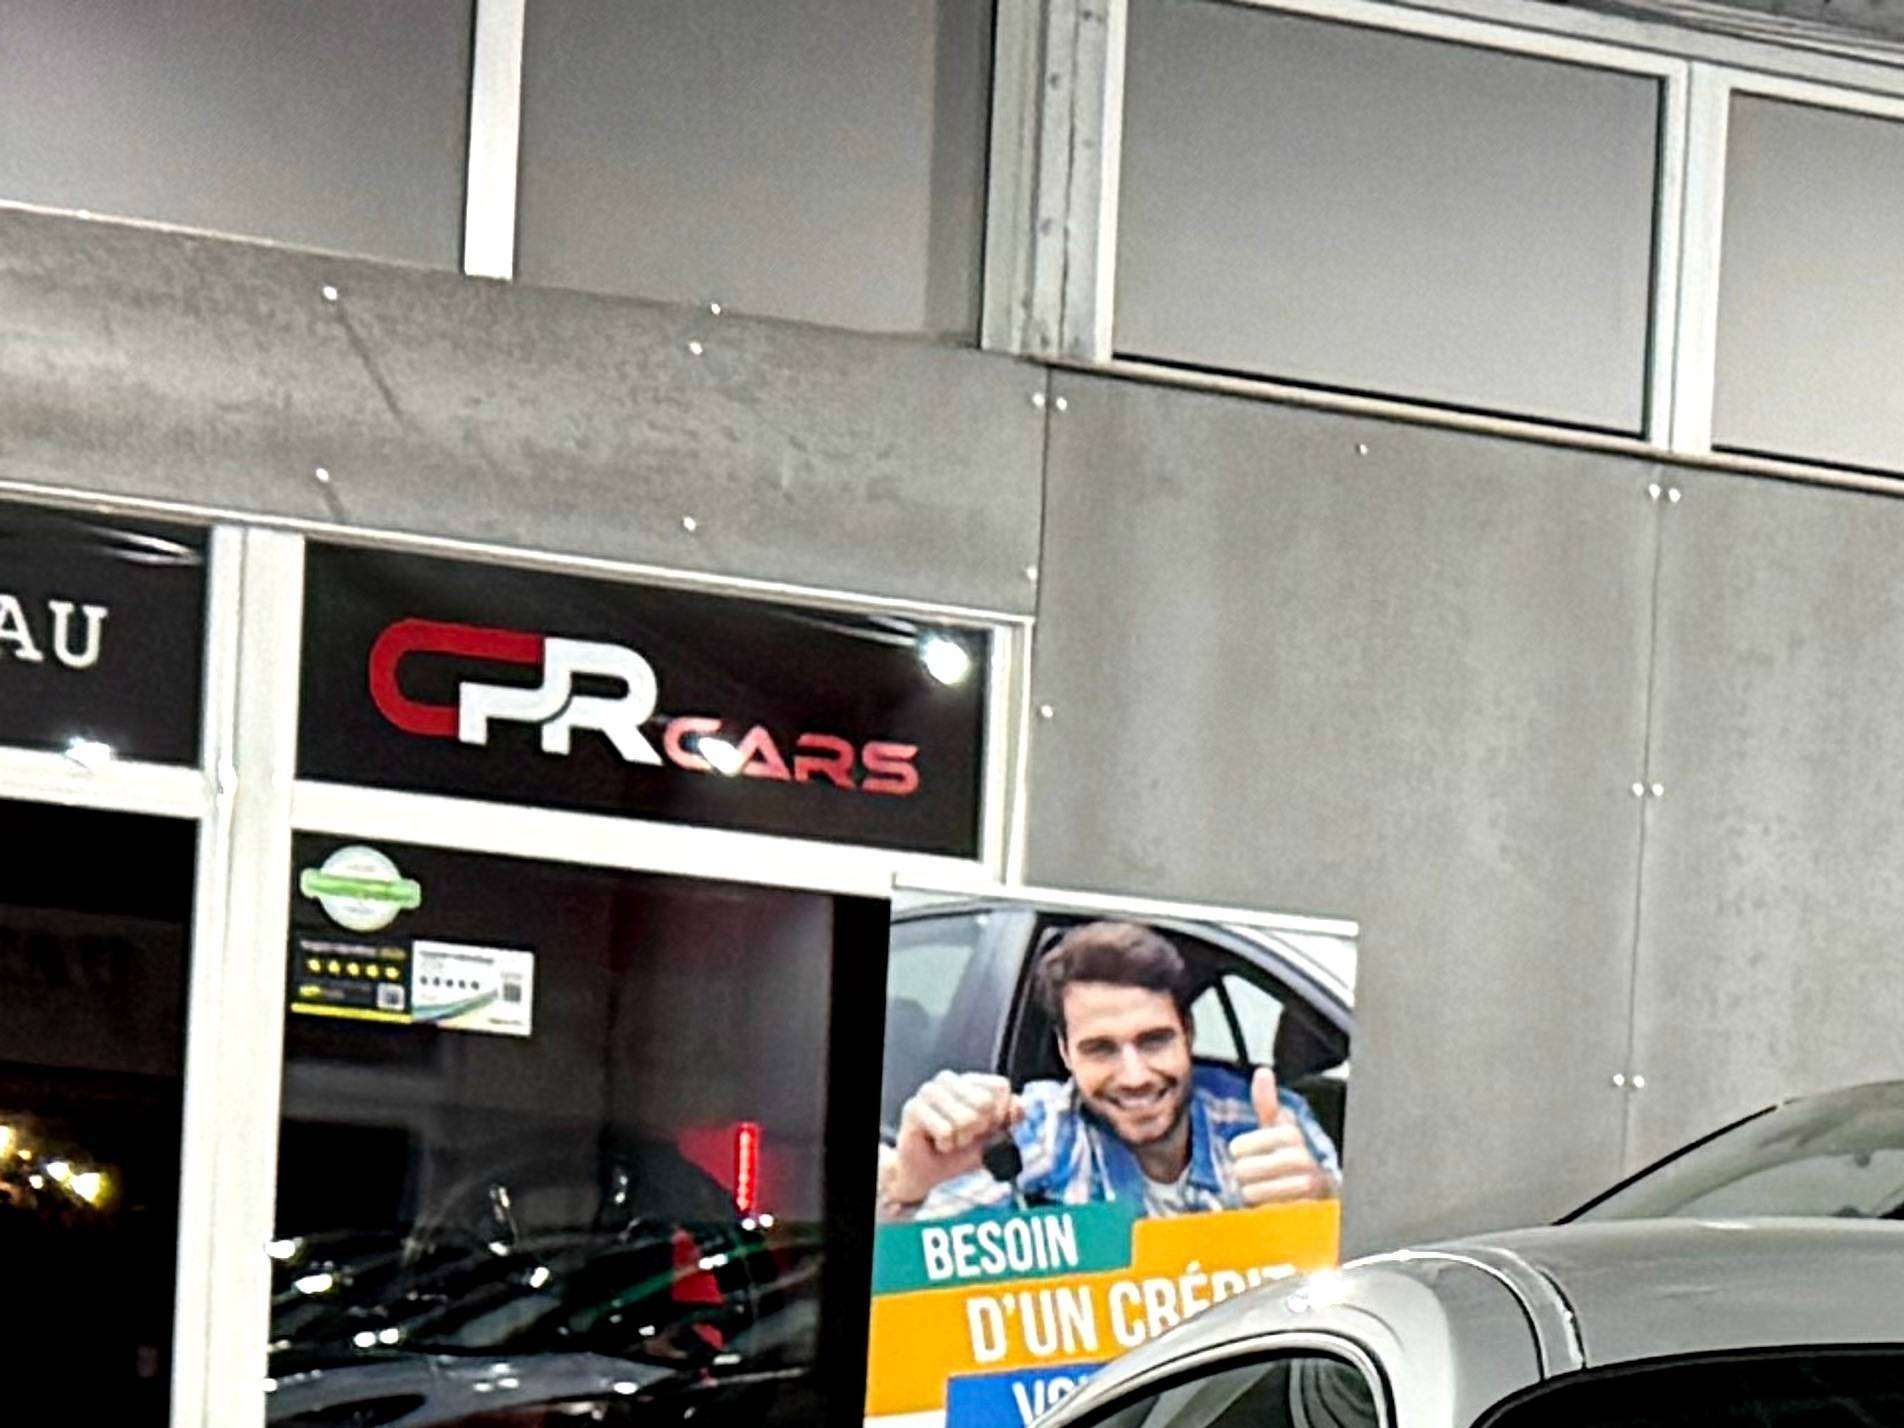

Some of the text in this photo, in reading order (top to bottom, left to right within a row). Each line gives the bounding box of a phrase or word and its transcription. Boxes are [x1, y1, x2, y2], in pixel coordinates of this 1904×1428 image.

[369, 619, 920, 796] CPR CARS
[921, 1214, 1079, 1281] BESOIN
[966, 1260, 1296, 1363] D'UN CRÉ
